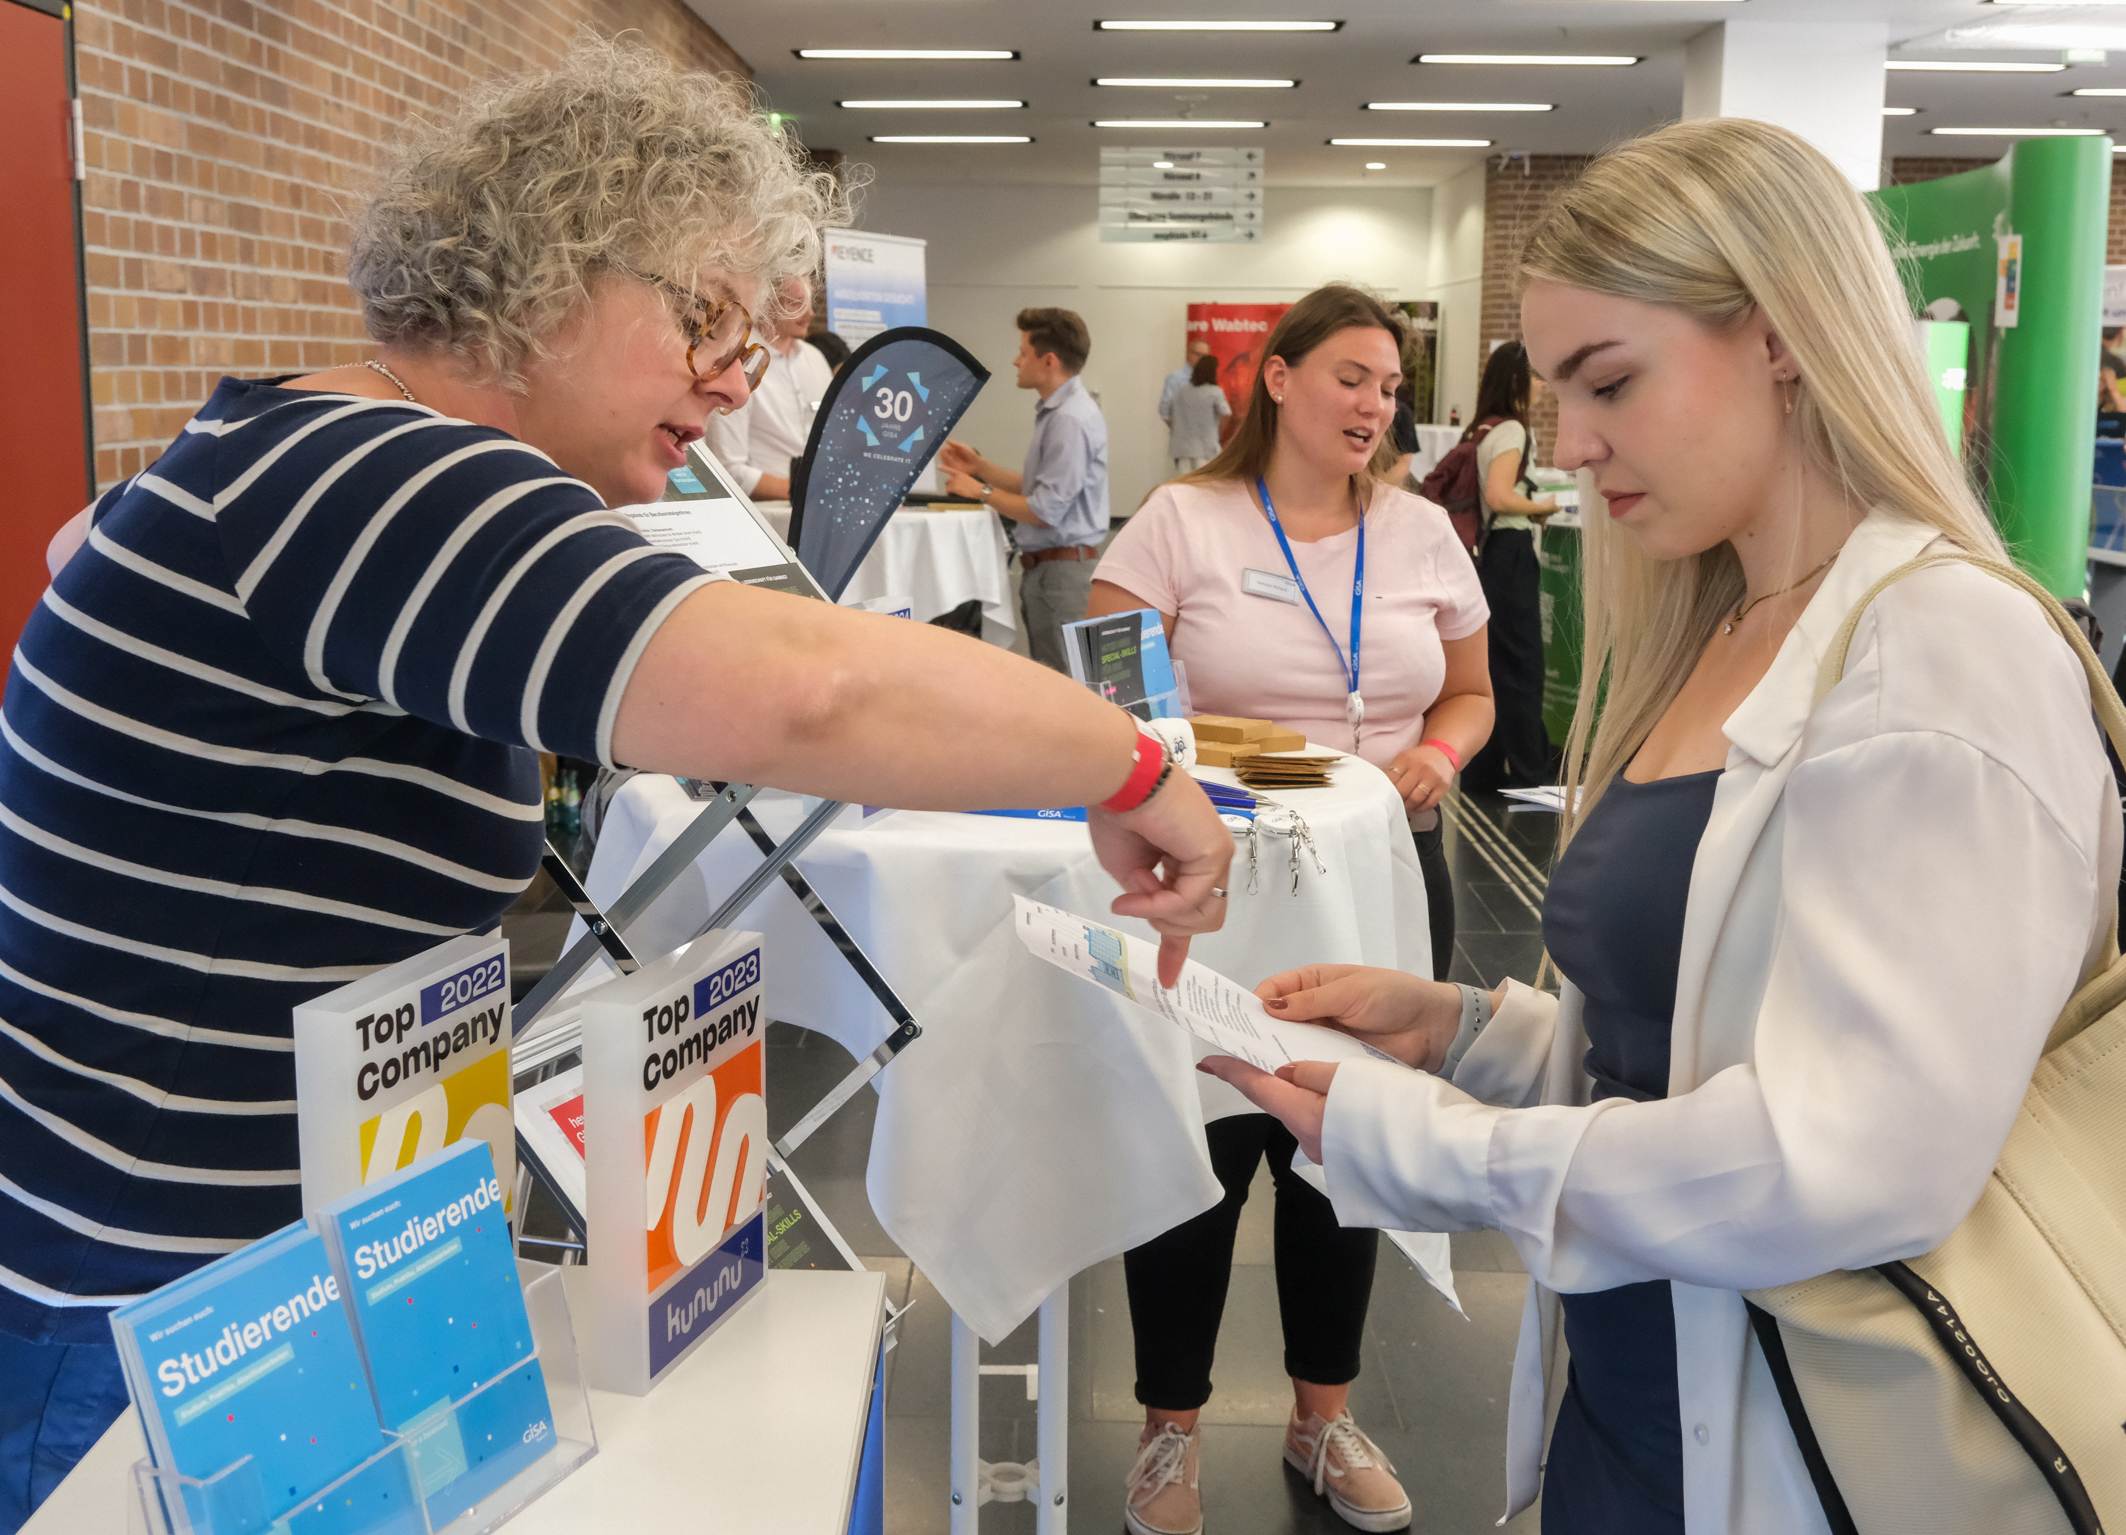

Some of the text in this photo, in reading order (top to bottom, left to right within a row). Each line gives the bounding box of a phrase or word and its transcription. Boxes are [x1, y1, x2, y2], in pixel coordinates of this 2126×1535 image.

[1212, 317, 1269, 333] Wabtec
[874, 387, 913, 422] 30
[881, 422, 902, 431] JAHRE
[863, 451, 872, 459] WE
[873, 453, 904, 464] CELEBRATE
[356, 960, 502, 1052] Top 2022
[642, 954, 759, 1043] Top 2023
[357, 1001, 506, 1101] Company
[643, 994, 760, 1091] Company
[568, 1115, 585, 1129] he
[354, 1177, 501, 1279] Studierende
[361, 1208, 385, 1225] suchen
[767, 1209, 802, 1245] AL-SKILLS
[667, 1259, 743, 1343] kununu
[157, 1274, 341, 1398] Studierende
[164, 1316, 194, 1336] suchen
[2053, 1456, 2068, 1474] R
